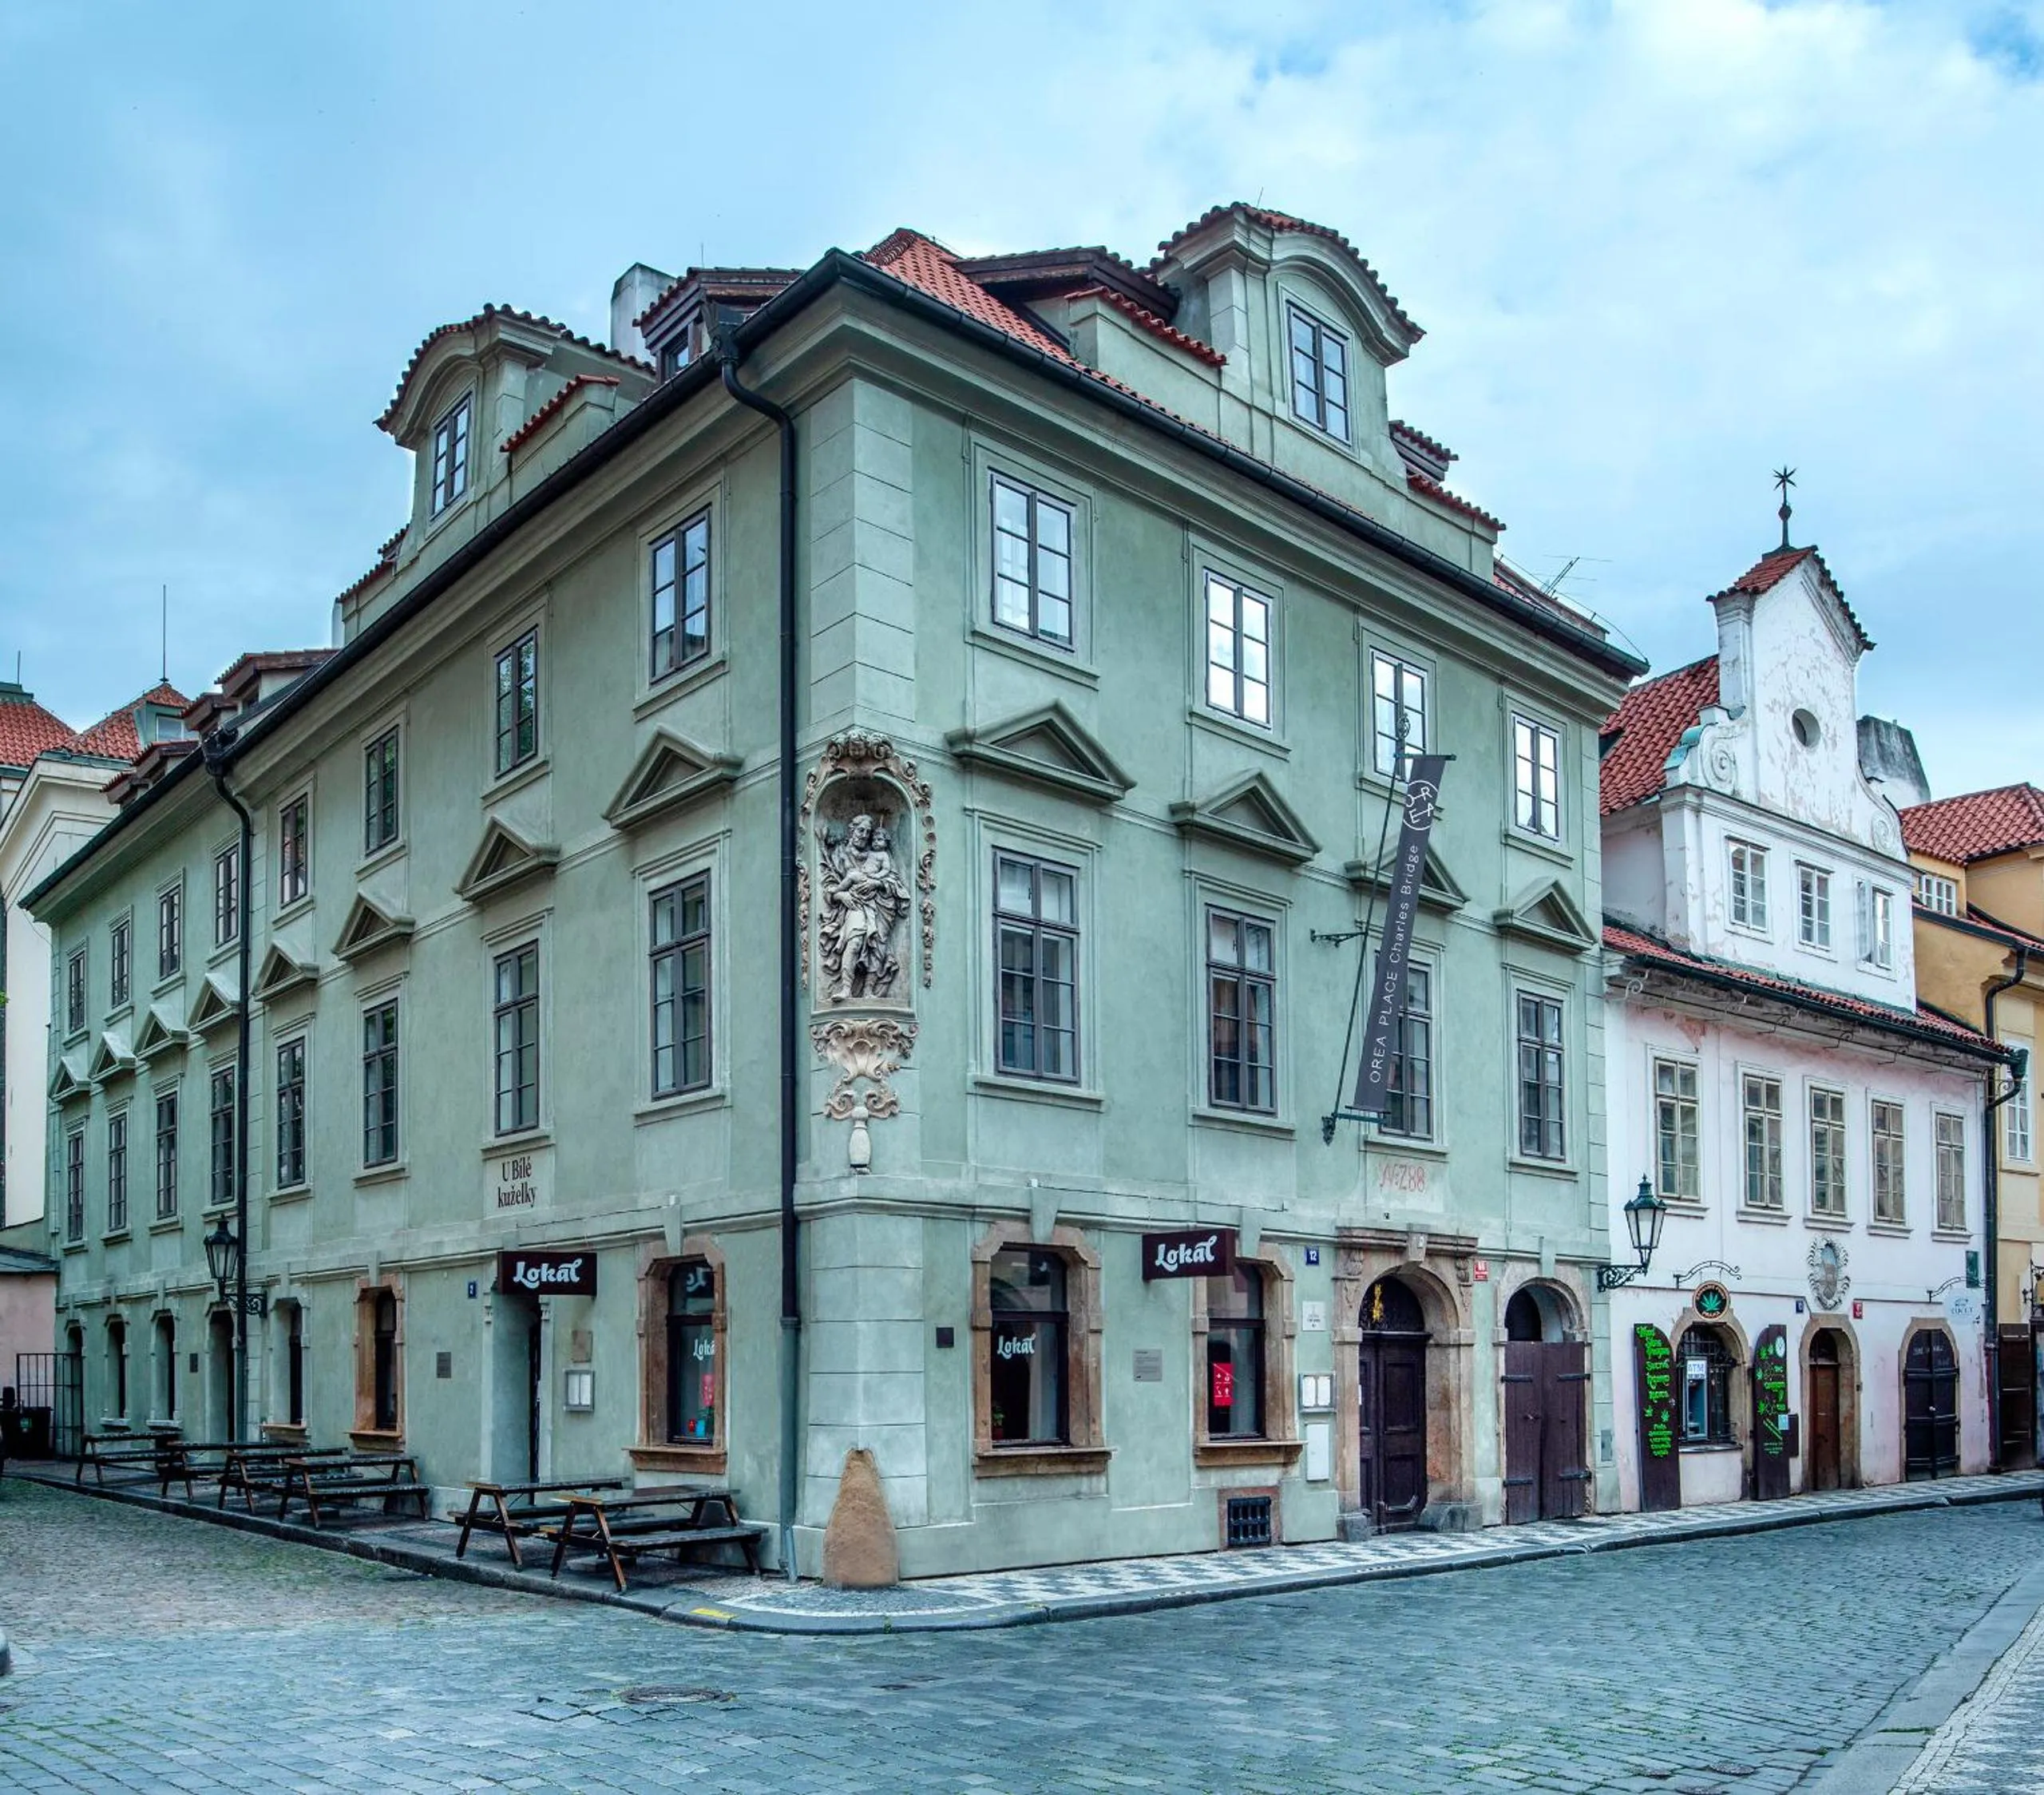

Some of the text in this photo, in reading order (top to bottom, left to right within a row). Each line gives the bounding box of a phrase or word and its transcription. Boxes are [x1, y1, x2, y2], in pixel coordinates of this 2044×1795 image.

[1369, 845, 1419, 1084] OREA PLACE Charles Bridge
[502, 1155, 532, 1182] U Bílé
[497, 1182, 537, 1208] kuželky
[1309, 1250, 1317, 1261] 12
